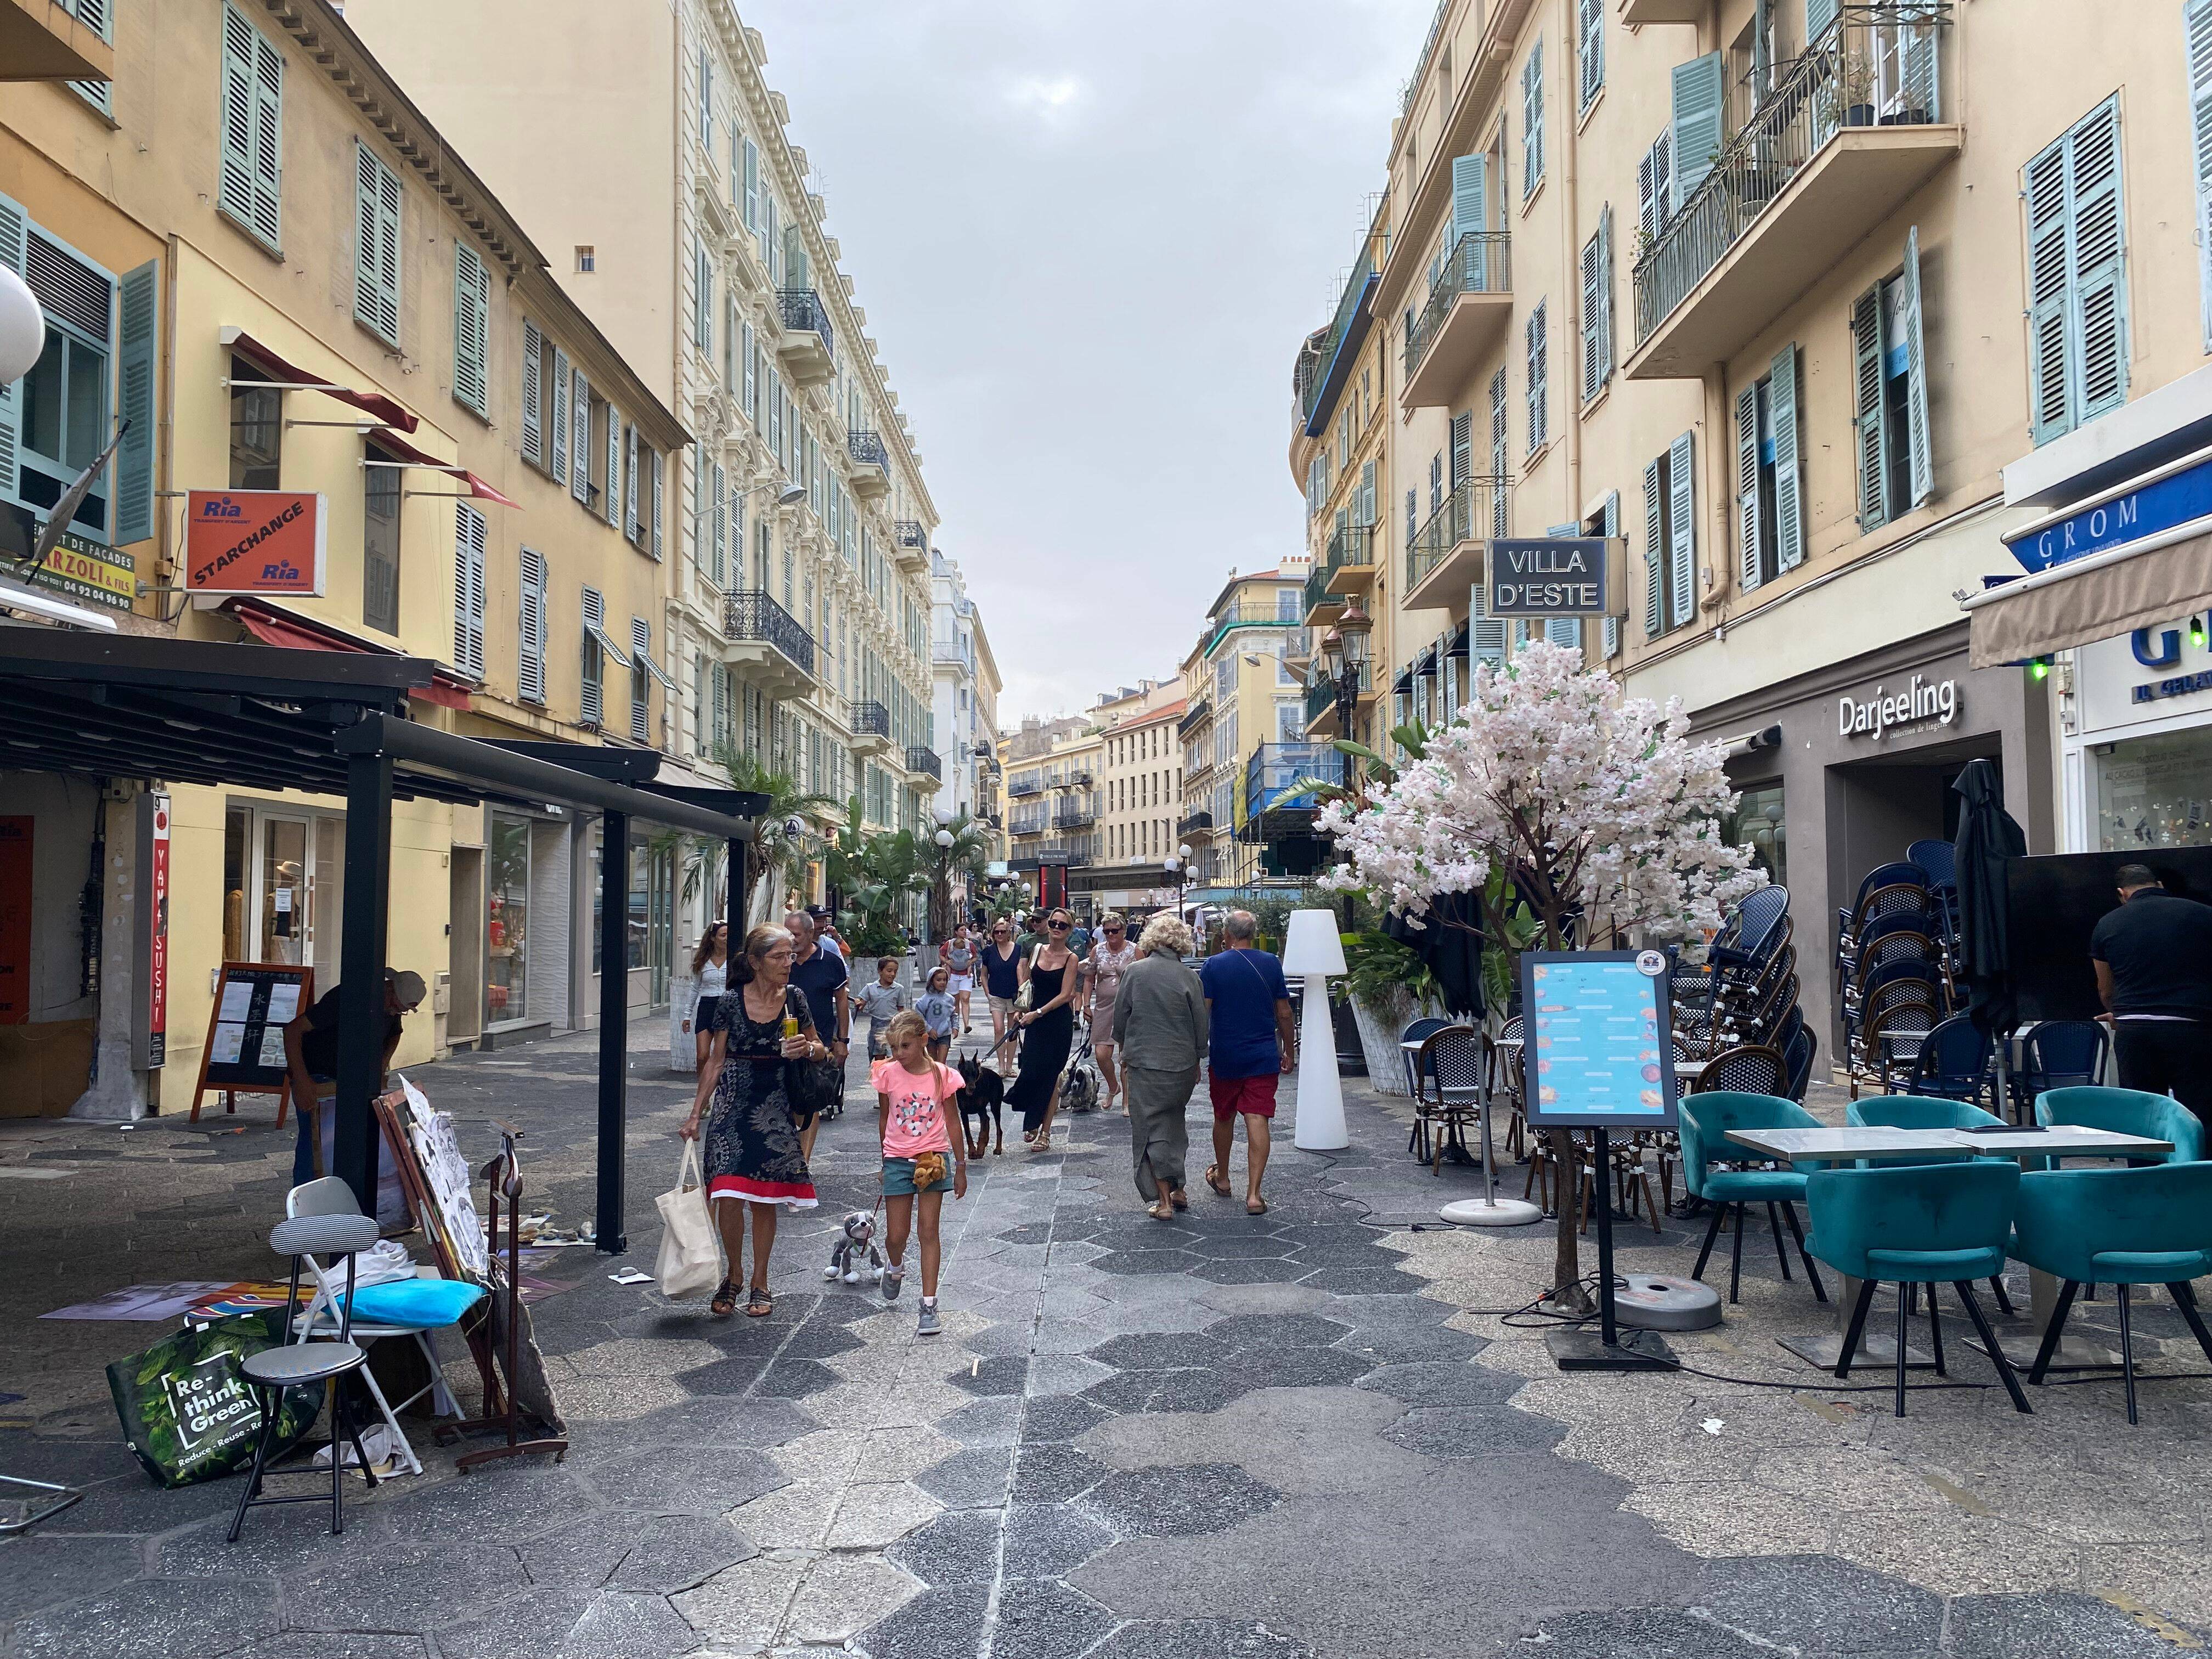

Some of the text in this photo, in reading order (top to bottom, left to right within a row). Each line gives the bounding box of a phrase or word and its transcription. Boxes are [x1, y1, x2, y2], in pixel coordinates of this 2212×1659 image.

[203, 496, 241, 517] Ria
[2039, 495, 2137, 558] GROM
[72, 538, 83, 551] DE
[89, 544, 131, 568] FAÇADES
[194, 501, 304, 585] STARCHANGE
[261, 559, 299, 580] Ria
[1509, 550, 1587, 573] VILLA
[49, 578, 62, 587] 9001
[64, 580, 76, 593] 04
[78, 586, 90, 598] 92
[93, 590, 104, 601] 04
[106, 594, 116, 605] 96
[119, 598, 129, 609] 90
[106, 575, 112, 586] &
[115, 578, 129, 592] FILS
[1498, 583, 1598, 606] D'ESTE
[2136, 685, 2154, 701] IL
[1839, 674, 1957, 740] Darjeeling
[1890, 727, 1916, 740] collection
[1917, 724, 1924, 733] de
[155, 798, 160, 810] 9
[1210, 878, 1243, 887] MAGENTA
[155, 935, 163, 1023] SUSHI
[933, 1003, 942, 1015] 8
[176, 1376, 213, 1397] Re-
[184, 1378, 246, 1418] think
[190, 1399, 253, 1432] Green
[178, 1447, 211, 1468] Reduce
[218, 1429, 245, 1447] Reuse
